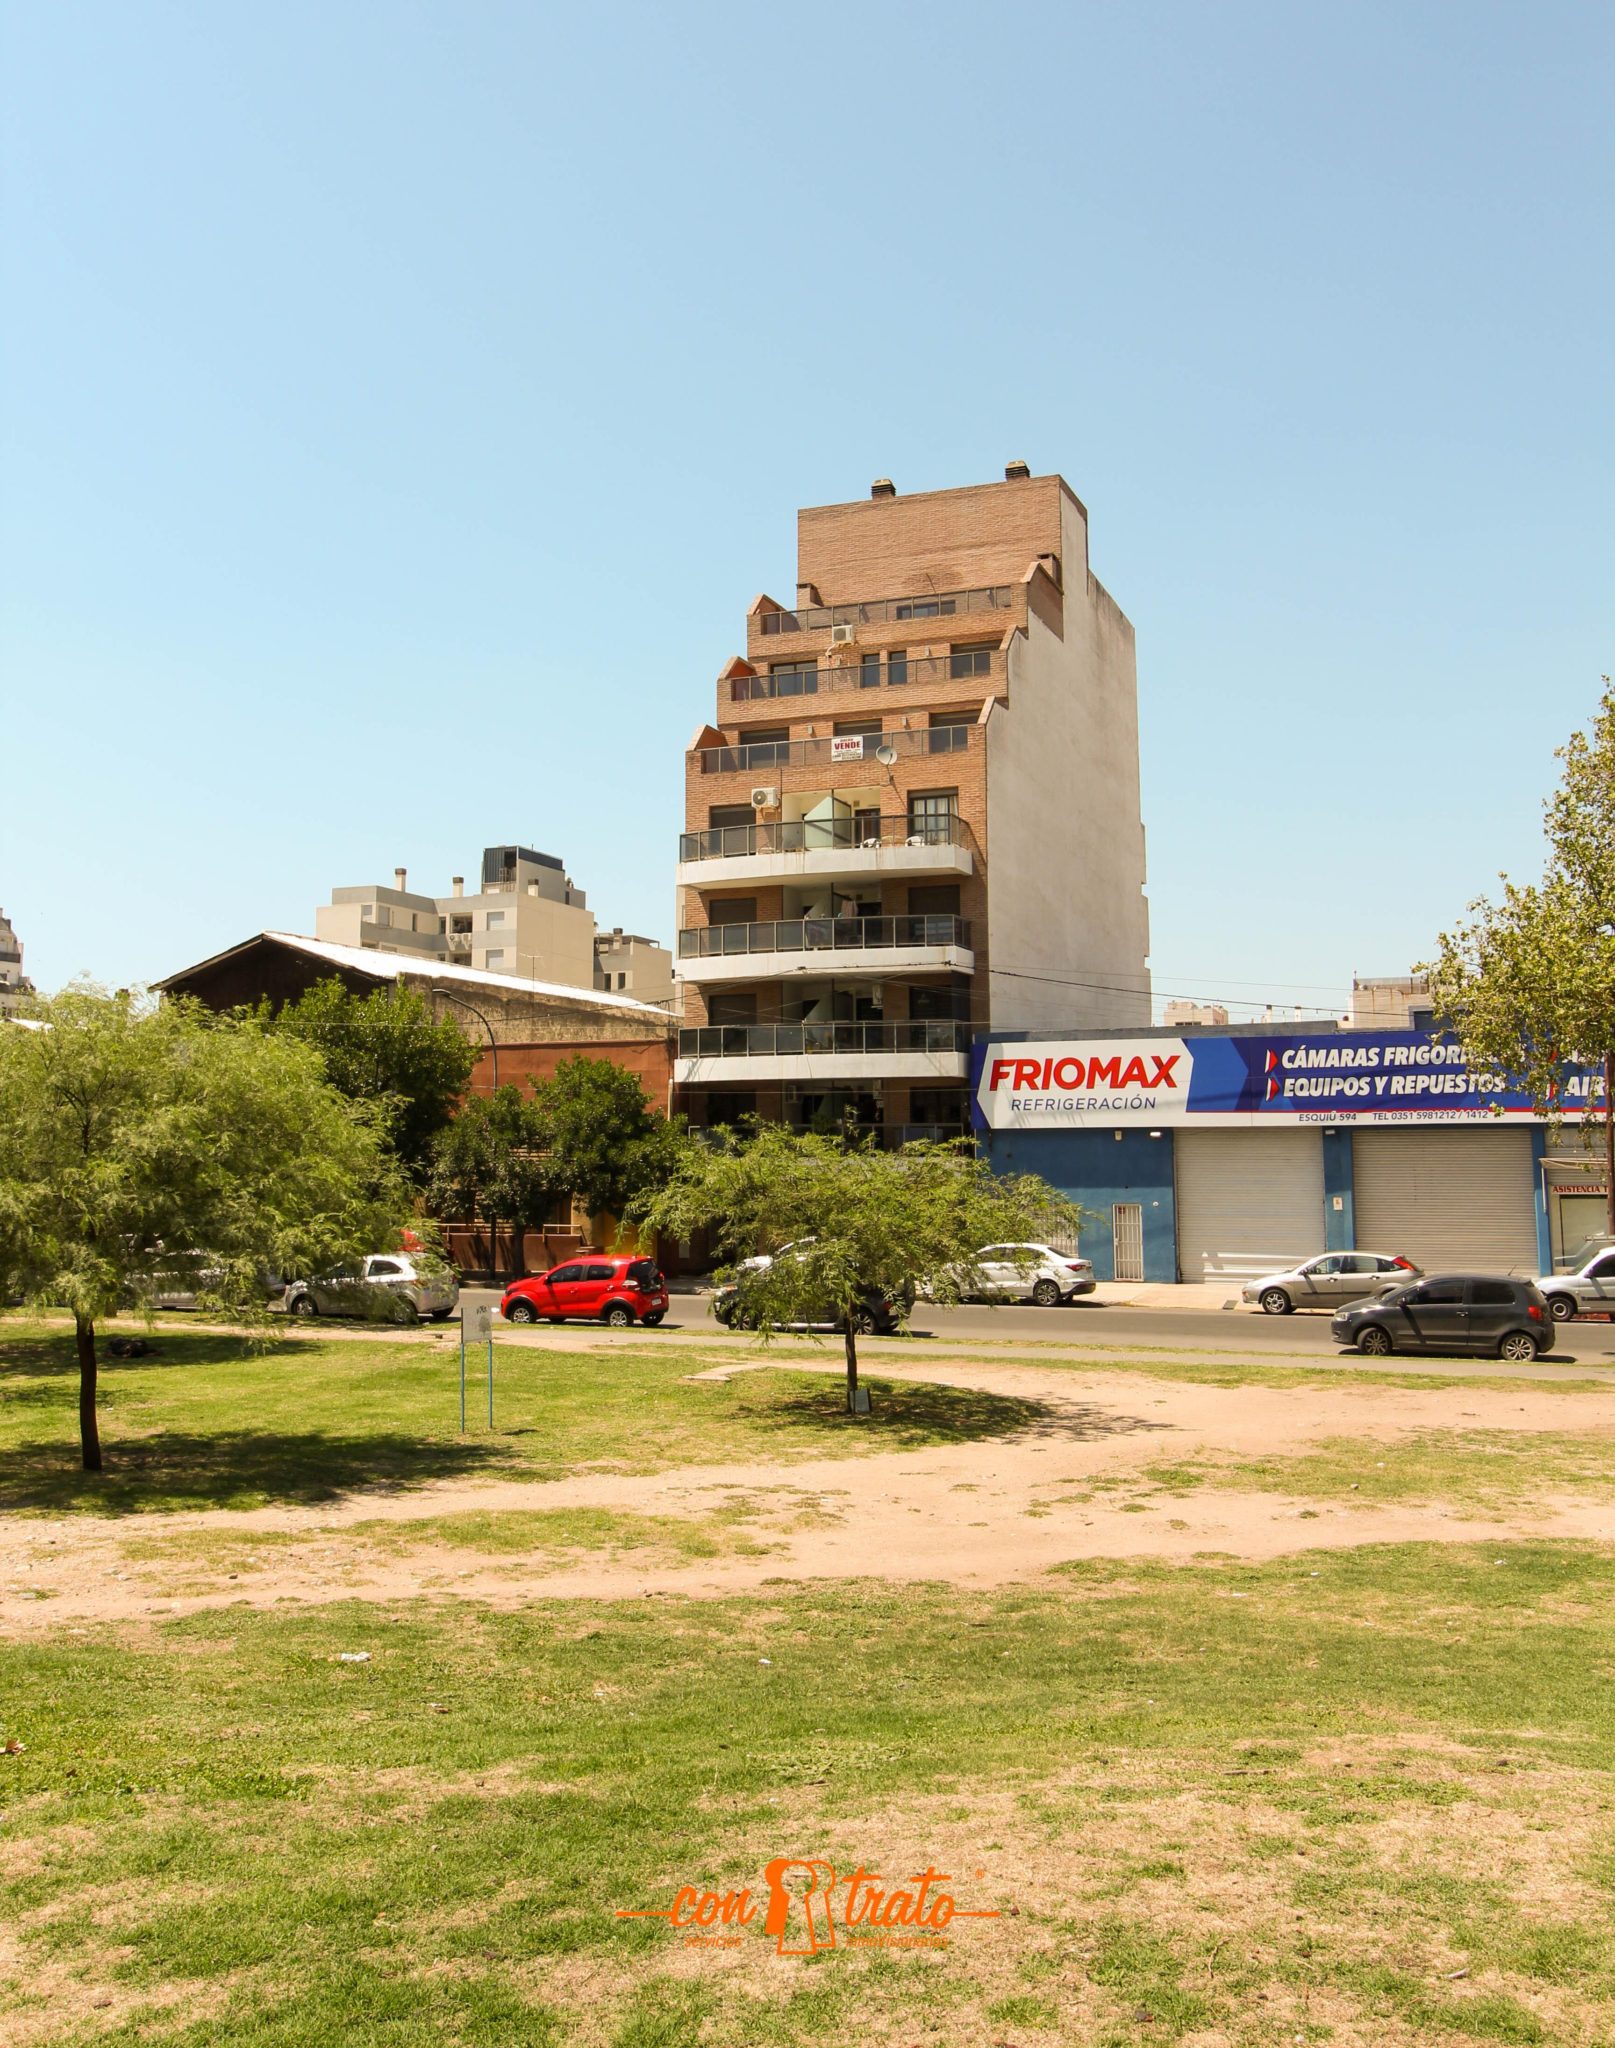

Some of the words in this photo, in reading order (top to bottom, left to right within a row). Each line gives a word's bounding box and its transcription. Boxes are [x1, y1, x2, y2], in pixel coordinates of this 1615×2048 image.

[834, 741, 861, 750] VENDE
[1282, 1045, 1380, 1068] CÁMARAS
[989, 1055, 1181, 1091] FRIOMAX
[1283, 1076, 1371, 1097] EQUIPOS
[1375, 1076, 1388, 1096] Y
[1390, 1072, 1504, 1095] REPUESTOS
[1011, 1093, 1156, 1111] REFRIGERACIÓN
[1339, 1112, 1357, 1121] 594
[1373, 1112, 1389, 1121] TEL
[1391, 1111, 1414, 1120] 0351
[1416, 1110, 1456, 1120] 5981212
[1466, 1110, 1488, 1119] 1412
